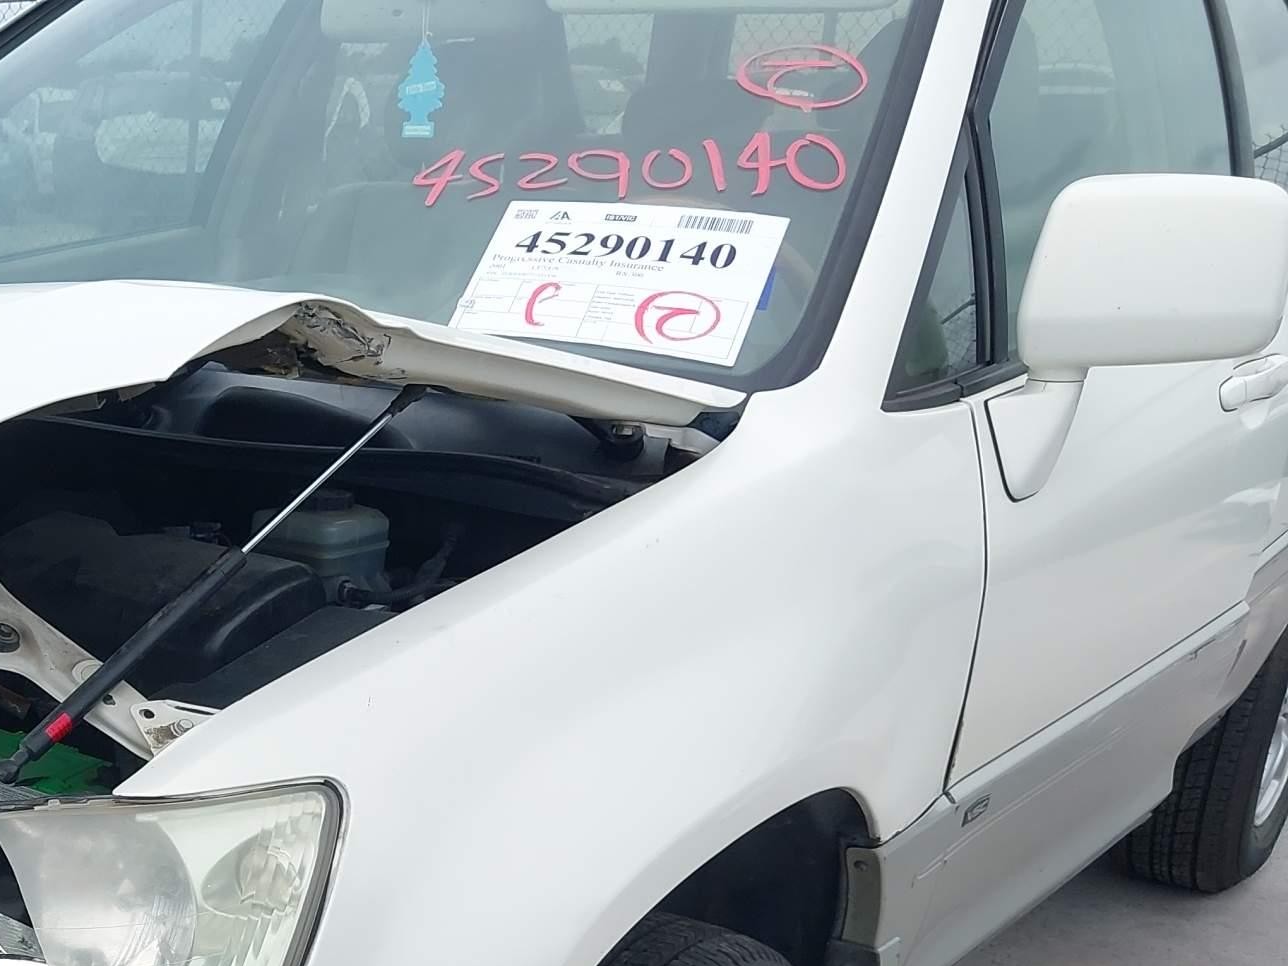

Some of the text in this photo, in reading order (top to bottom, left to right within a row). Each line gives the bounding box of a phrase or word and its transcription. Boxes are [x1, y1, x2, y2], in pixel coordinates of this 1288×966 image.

[412, 131, 846, 206] 45290140
[492, 253, 664, 272] Progressive Casualty Insurance
[514, 230, 737, 269] 45290140
